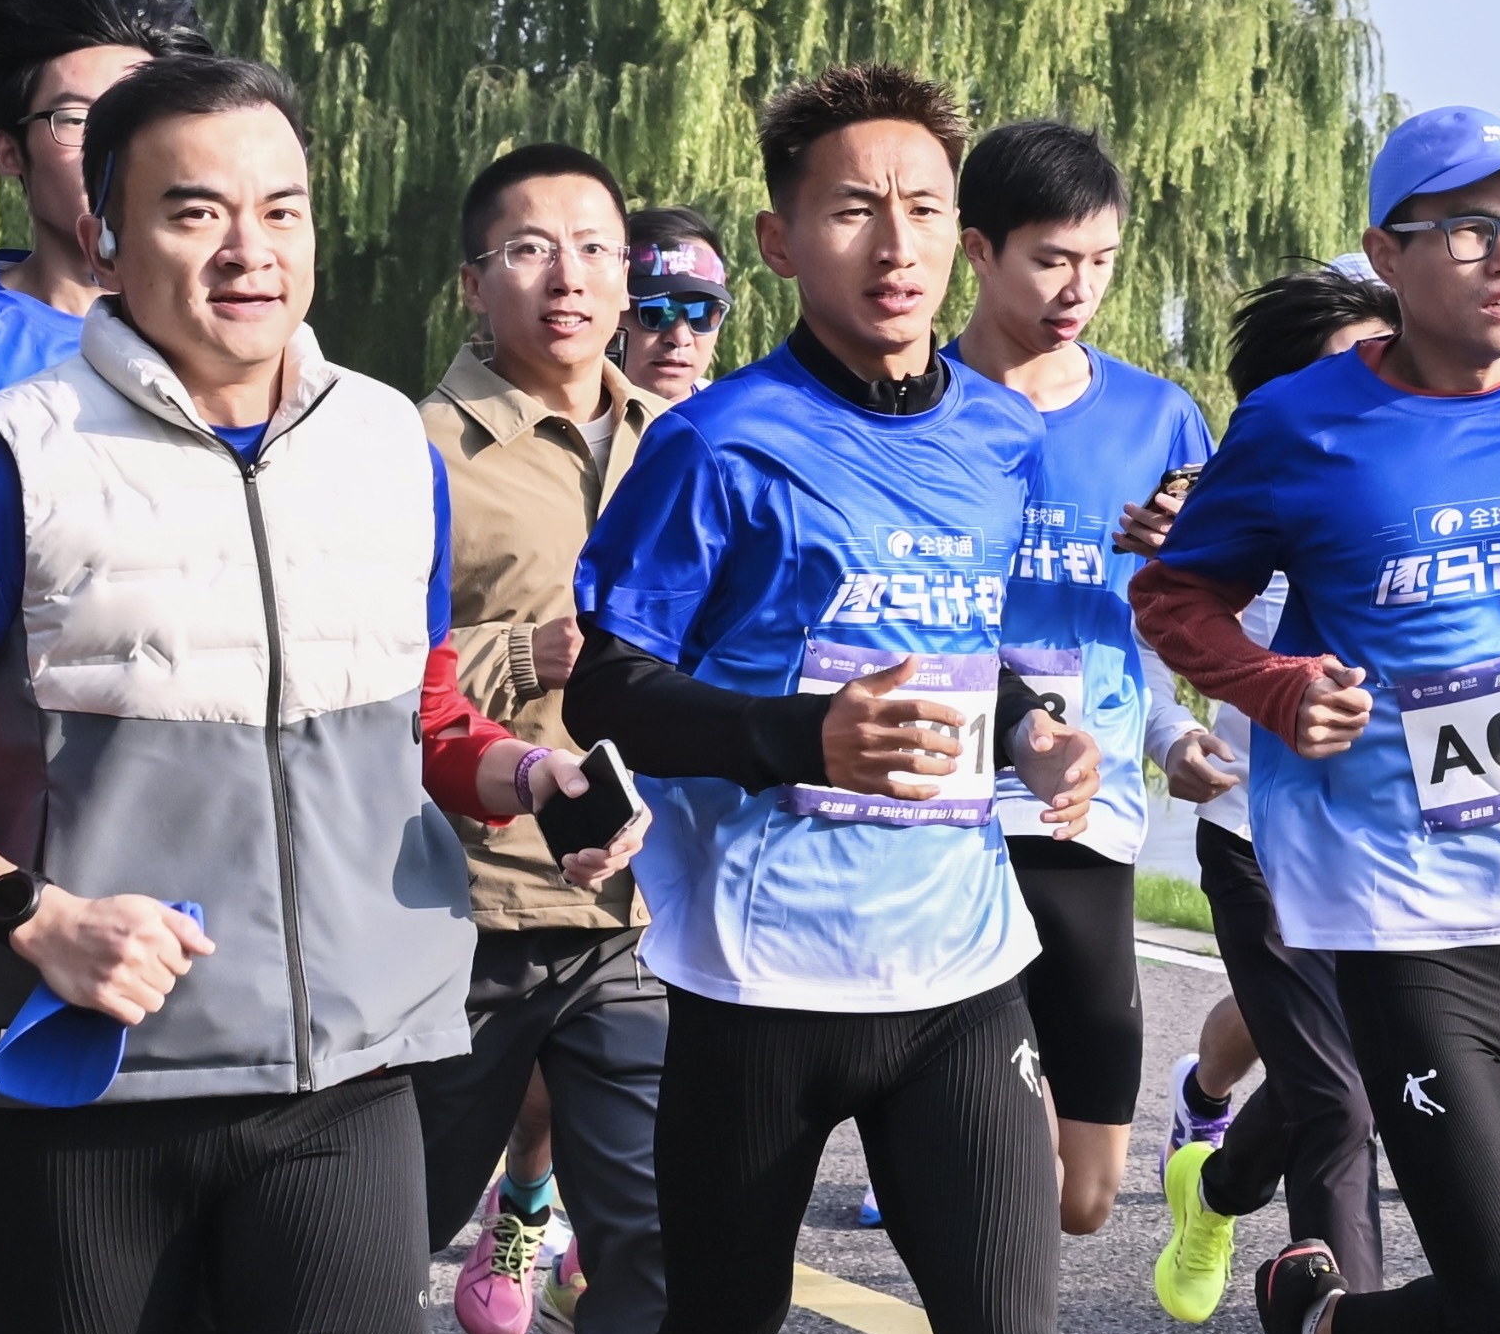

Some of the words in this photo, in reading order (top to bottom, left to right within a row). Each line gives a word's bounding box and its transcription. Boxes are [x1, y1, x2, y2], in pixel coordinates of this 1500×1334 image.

[918, 535, 973, 557] 全球通
[1010, 539, 1103, 585] 计划
